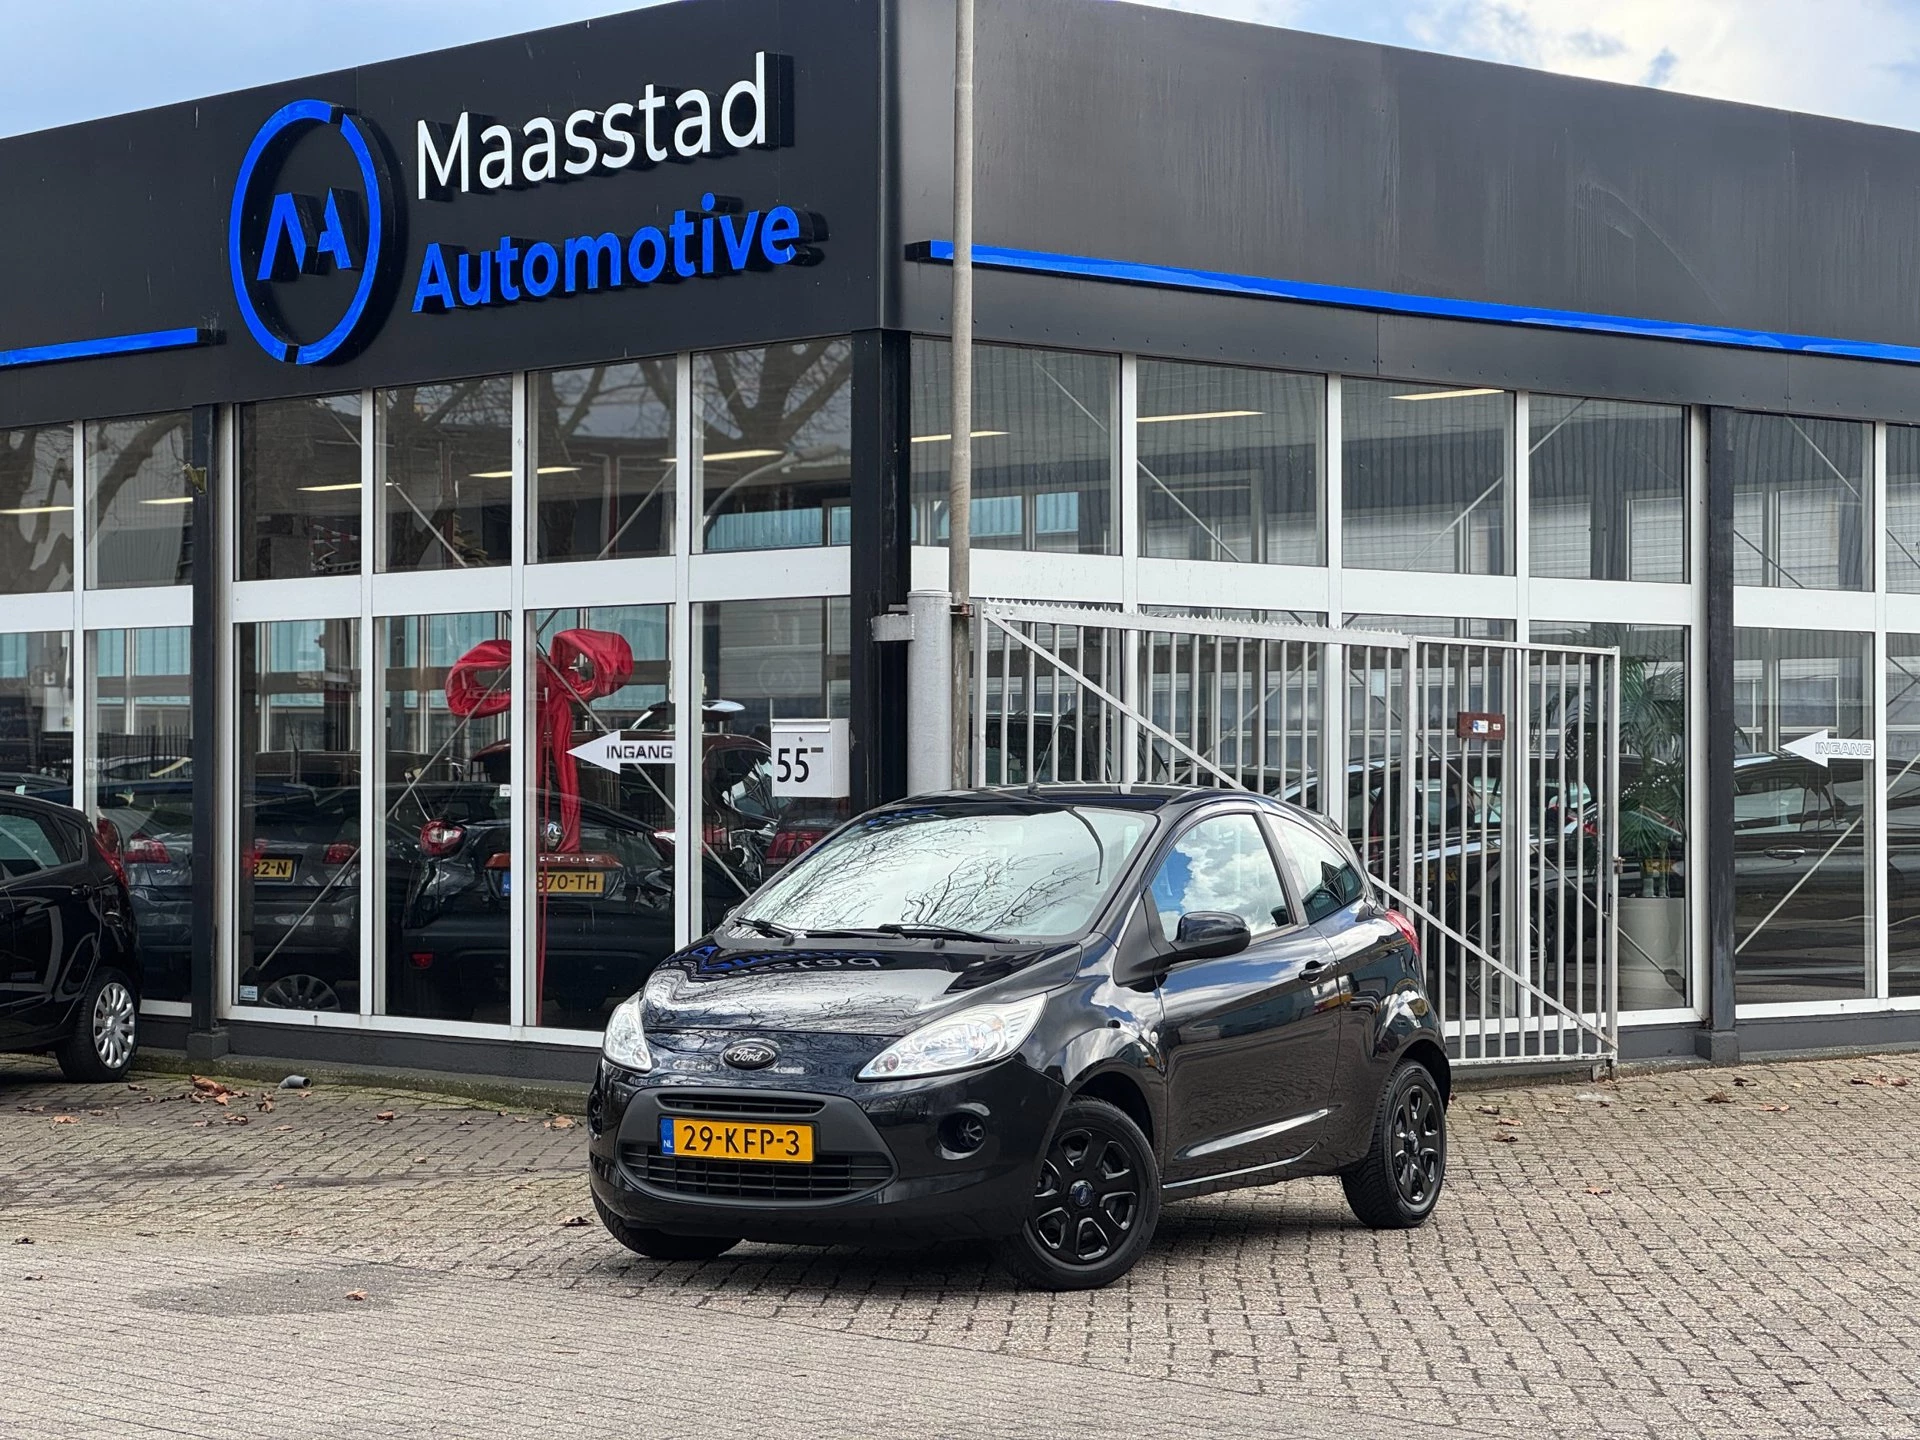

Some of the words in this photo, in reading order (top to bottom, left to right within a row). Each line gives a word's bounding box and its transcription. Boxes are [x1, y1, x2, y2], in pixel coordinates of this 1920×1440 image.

[417, 51, 766, 199] Maasstad
[411, 192, 801, 313] Automotive
[606, 745, 673, 760] INGANG
[1814, 741, 1872, 756] INGANG
[733, 1048, 768, 1062] Ford
[663, 1140, 673, 1148] NL
[683, 1124, 800, 1156] 29-KFP-3
